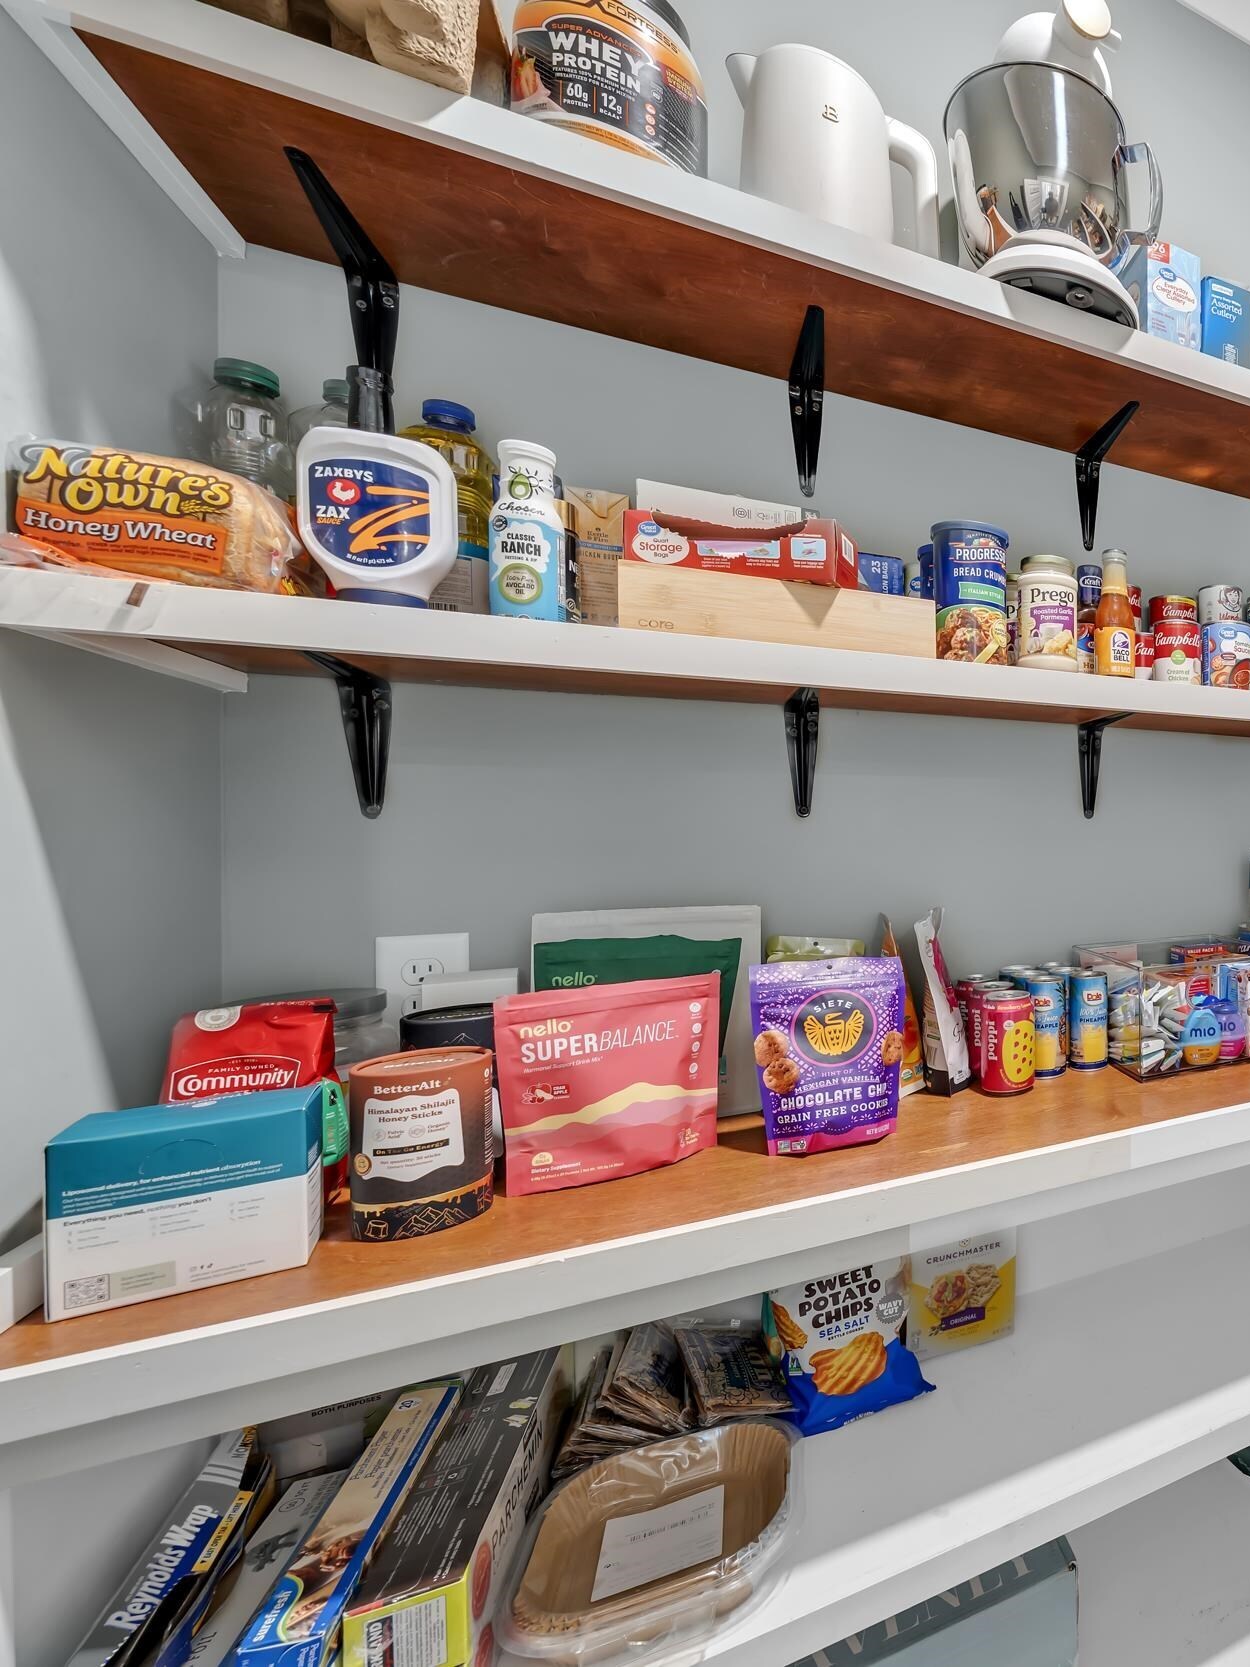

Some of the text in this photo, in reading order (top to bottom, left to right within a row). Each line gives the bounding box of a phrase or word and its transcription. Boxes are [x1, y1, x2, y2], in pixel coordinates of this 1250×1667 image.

[551, 23, 583, 32] SUPER
[549, 31, 644, 77] WHEY
[552, 52, 641, 93] PROTEIN
[566, 82, 623, 115] 60g 12g
[1164, 279, 1189, 297] Everyday
[1211, 297, 1243, 315] Assorted
[1211, 306, 1237, 323] Cutlery
[22, 446, 234, 508] Nature's
[314, 465, 374, 483] ZAXBYS
[63, 477, 181, 516] Own
[316, 505, 350, 519] ZAX
[498, 502, 546, 516] Chosen
[24, 507, 120, 541] Honey
[124, 520, 217, 550] Wheat
[506, 532, 536, 543] CLASSIC
[501, 541, 542, 557] RANCH
[639, 541, 683, 553] Storage
[953, 567, 982, 577] BREAD
[505, 582, 535, 590] AVOCADO
[1084, 577, 1101, 586] Kraft
[1030, 588, 1075, 607] Prego
[1033, 607, 1073, 616] Roasted Garlic
[638, 618, 675, 631] core
[1112, 648, 1130, 656] TACO
[552, 970, 595, 987] nello
[1034, 998, 1051, 1007] Dole
[1086, 992, 1102, 1001] Dole
[813, 999, 853, 1014] SIETE
[1080, 1007, 1095, 1016] 100%
[973, 1008, 982, 1047] poppi
[1079, 1014, 1108, 1024] PINEAPPLE
[519, 1018, 572, 1039] nello
[988, 1020, 998, 1061] poppi
[208, 1066, 241, 1074] FAMILY
[177, 1068, 295, 1096] Community
[373, 1079, 442, 1095] BetterAlt
[794, 1075, 880, 1095] MEXICAN VANILLA
[368, 1099, 455, 1115] Himalayan Shilajit
[780, 1087, 862, 1112] CHOCOLATE
[378, 1110, 443, 1123] Honey Sticks
[777, 1099, 889, 1125] GRAIN FREE COOKIES
[63, 1214, 107, 1227] Everything
[108, 1212, 124, 1221] you
[926, 1241, 1001, 1265] CRUNCHMASTER
[804, 1264, 874, 1299] SWEET
[799, 1279, 881, 1317] POTATO
[811, 1298, 874, 1329] CHIPS
[878, 1299, 903, 1317] WAVY CUT
[819, 1315, 870, 1339] SEA SALT
[950, 1312, 977, 1326] ORIGINAL
[312, 1394, 382, 1418] BOTH PURPOSES
[491, 1420, 545, 1561] PARCHEMIN
[104, 1503, 219, 1632] Reynolds Wrap
[252, 1590, 293, 1643] surefresh
